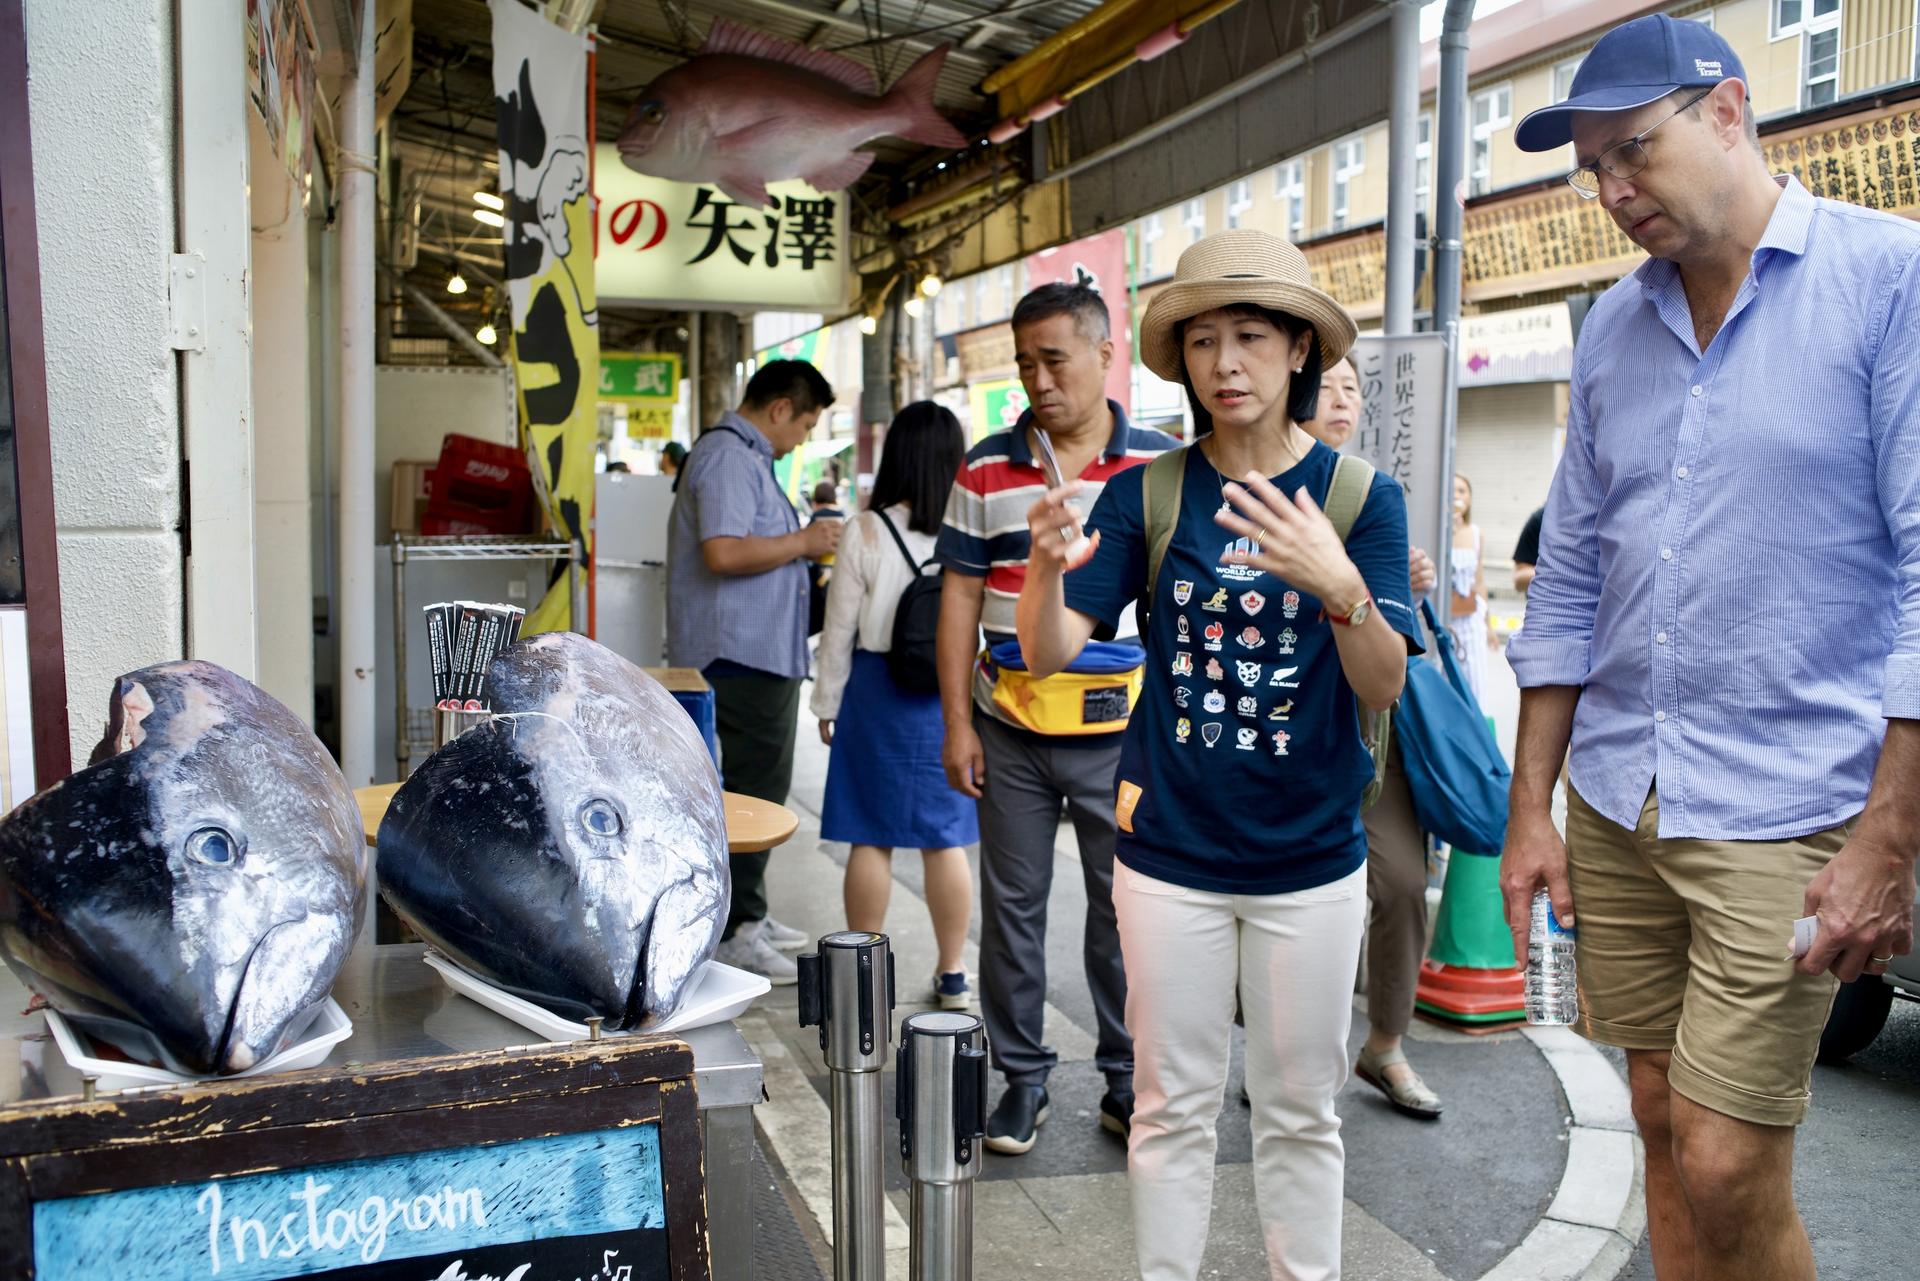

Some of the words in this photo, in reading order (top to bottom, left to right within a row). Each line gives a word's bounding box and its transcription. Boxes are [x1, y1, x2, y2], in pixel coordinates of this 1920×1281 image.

[1361, 355, 1383, 458] この辛口。
[1216, 566, 1246, 577] WORLD
[197, 1175, 487, 1275] Instagram
